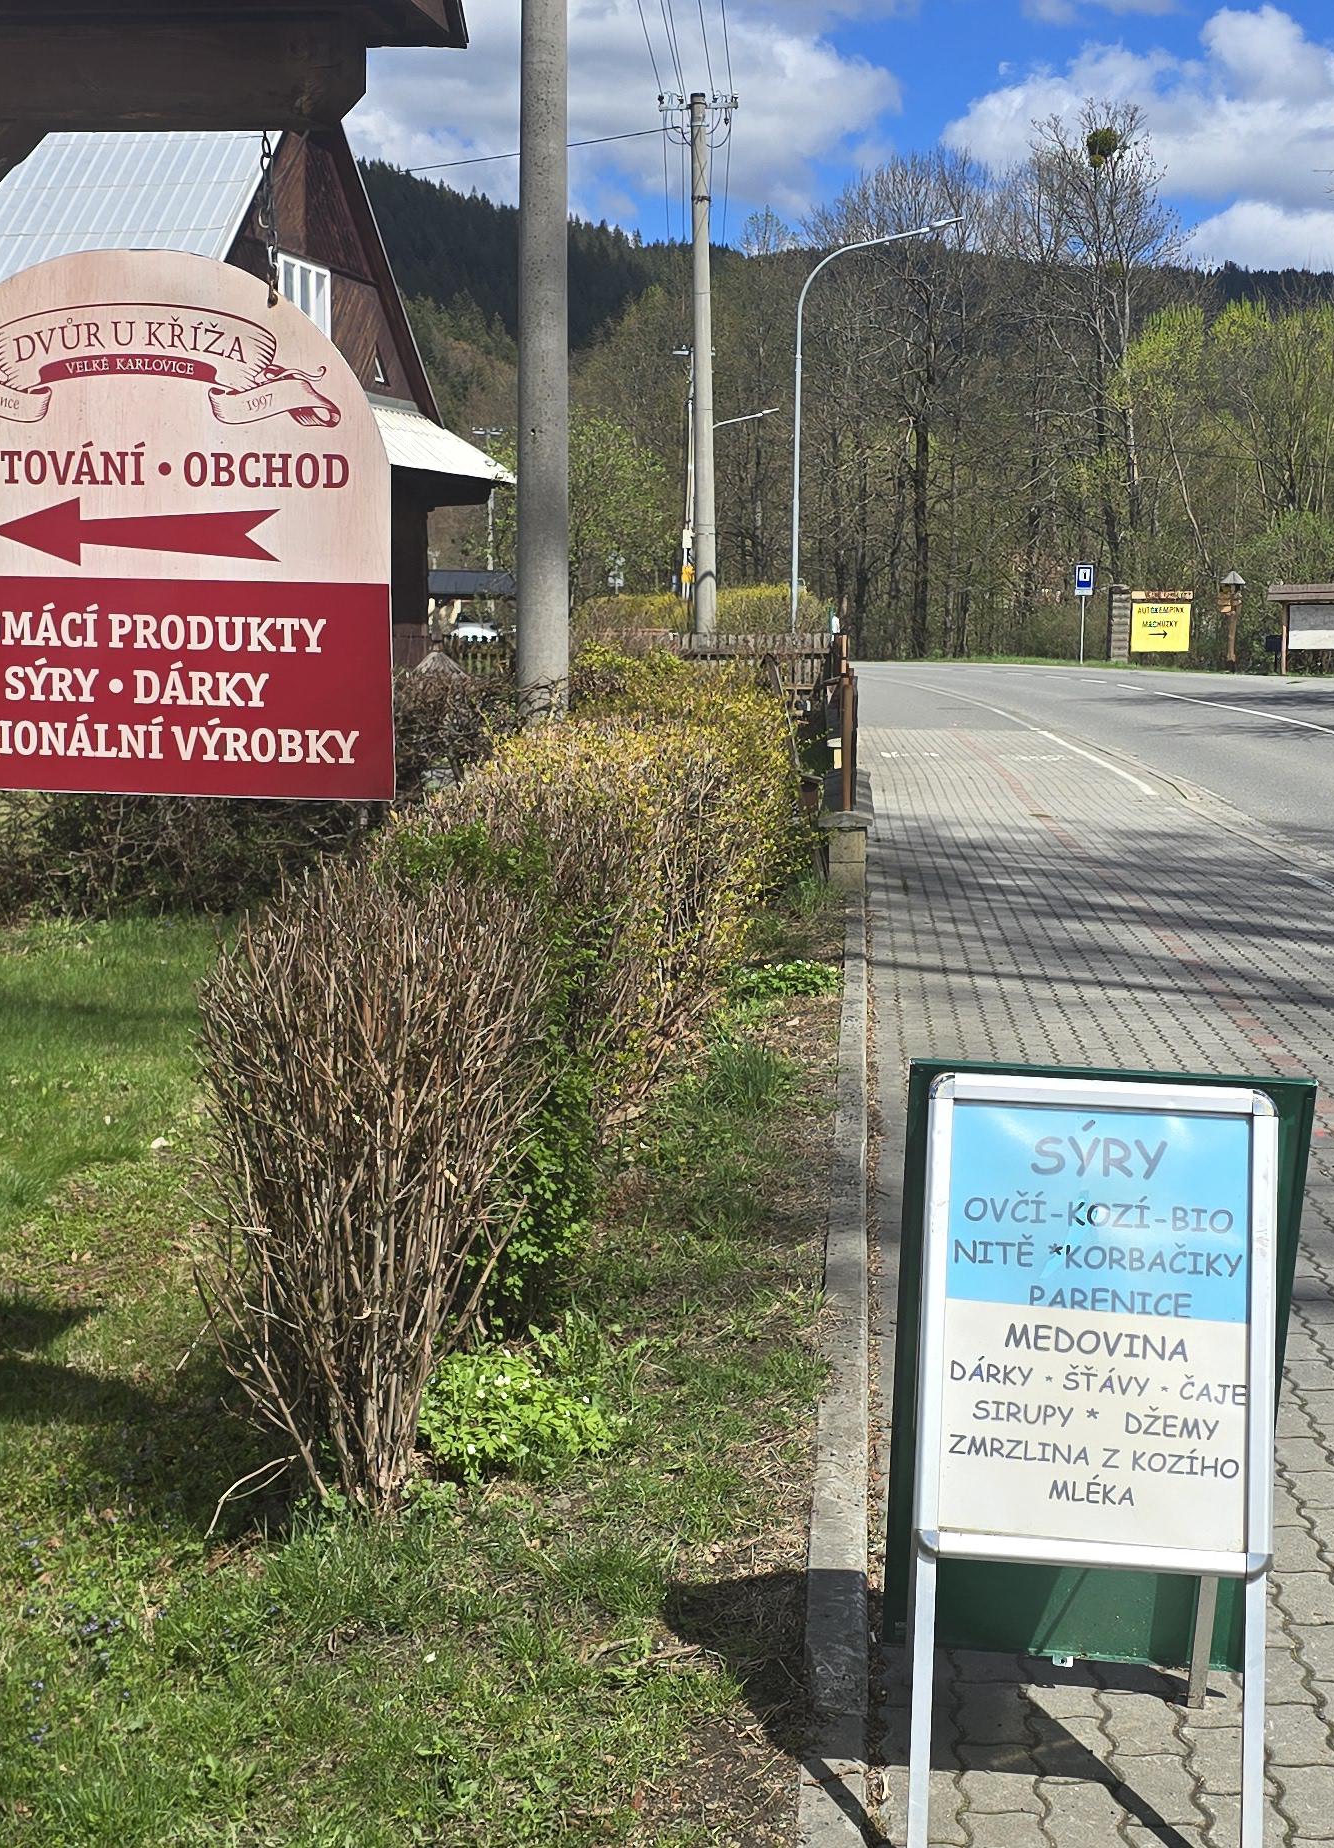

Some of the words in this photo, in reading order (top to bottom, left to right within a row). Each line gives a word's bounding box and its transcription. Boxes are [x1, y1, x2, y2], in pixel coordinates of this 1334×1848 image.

[13, 318, 106, 363] DVŮR
[113, 320, 135, 347] U
[145, 316, 248, 364] KŘÍŽA
[65, 357, 110, 374] VELKÉ
[116, 358, 195, 376] KARLOVICE
[246, 393, 274, 412] 1997
[183, 452, 350, 489] OBCHOD
[108, 612, 327, 654] PRODUKTY
[4, 657, 99, 704] SÝRY
[133, 662, 269, 708] DÁRKY
[171, 717, 360, 765] VÝROBKY
[1030, 1119, 1168, 1181] SÝRY
[964, 1189, 1234, 1234] OVČÍ-KOZÍ-BIO
[954, 1233, 1035, 1268] NITĚ
[1028, 1284, 1193, 1318] PARENICE
[1004, 1323, 1189, 1363] MEDOVINA
[950, 1356, 1034, 1388] DÁRKY
[1062, 1363, 1149, 1398] ŠŤÁVY
[1179, 1374, 1248, 1407] ČAJE
[972, 1400, 1074, 1428] SIRUPY
[1124, 1406, 1220, 1442] DŽEMY
[948, 1433, 1090, 1467] ZMRZLINA
[1102, 1447, 1121, 1470] Z
[1131, 1450, 1240, 1480] KOZÍHO
[1048, 1475, 1136, 1507] MLÉKA
